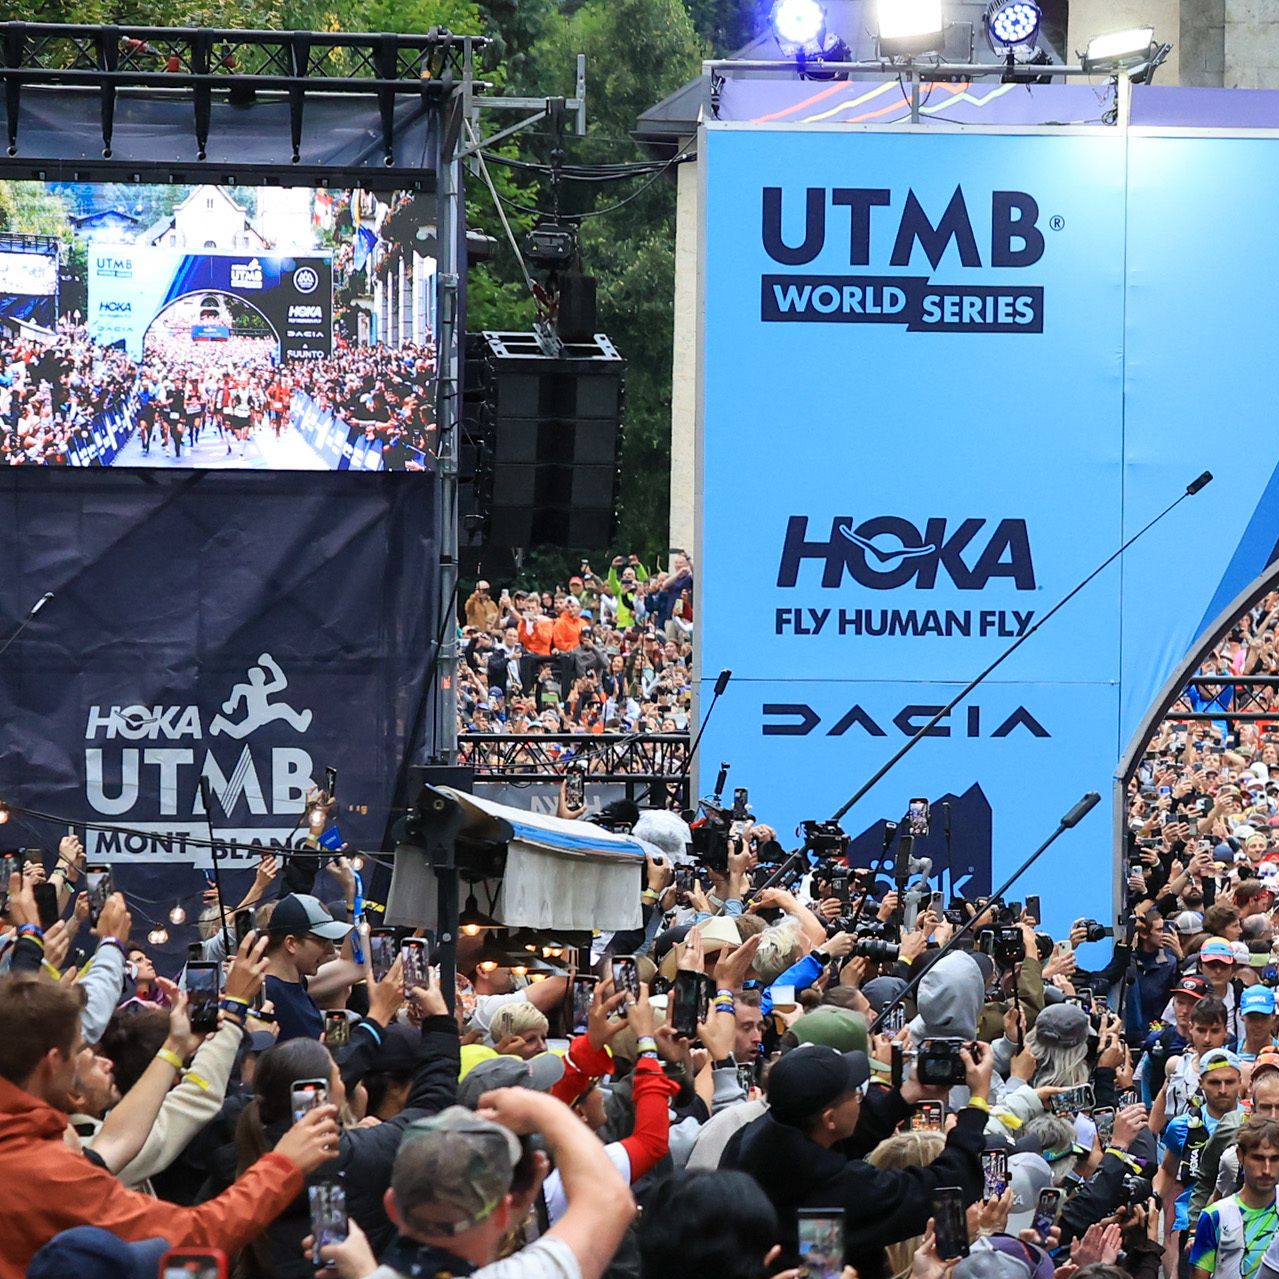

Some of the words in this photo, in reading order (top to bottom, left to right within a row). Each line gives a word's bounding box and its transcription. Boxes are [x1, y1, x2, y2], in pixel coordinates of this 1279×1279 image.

[773, 284, 906, 314] WORLD
[922, 295, 1034, 325] SERIES
[776, 515, 1037, 591] HOKA
[775, 608, 831, 635] FLY
[838, 609, 971, 637] HUMAN
[979, 610, 1036, 638] FLY
[85, 705, 203, 739] HOKA
[762, 703, 1052, 738] DACIA
[85, 743, 316, 819] UTMB
